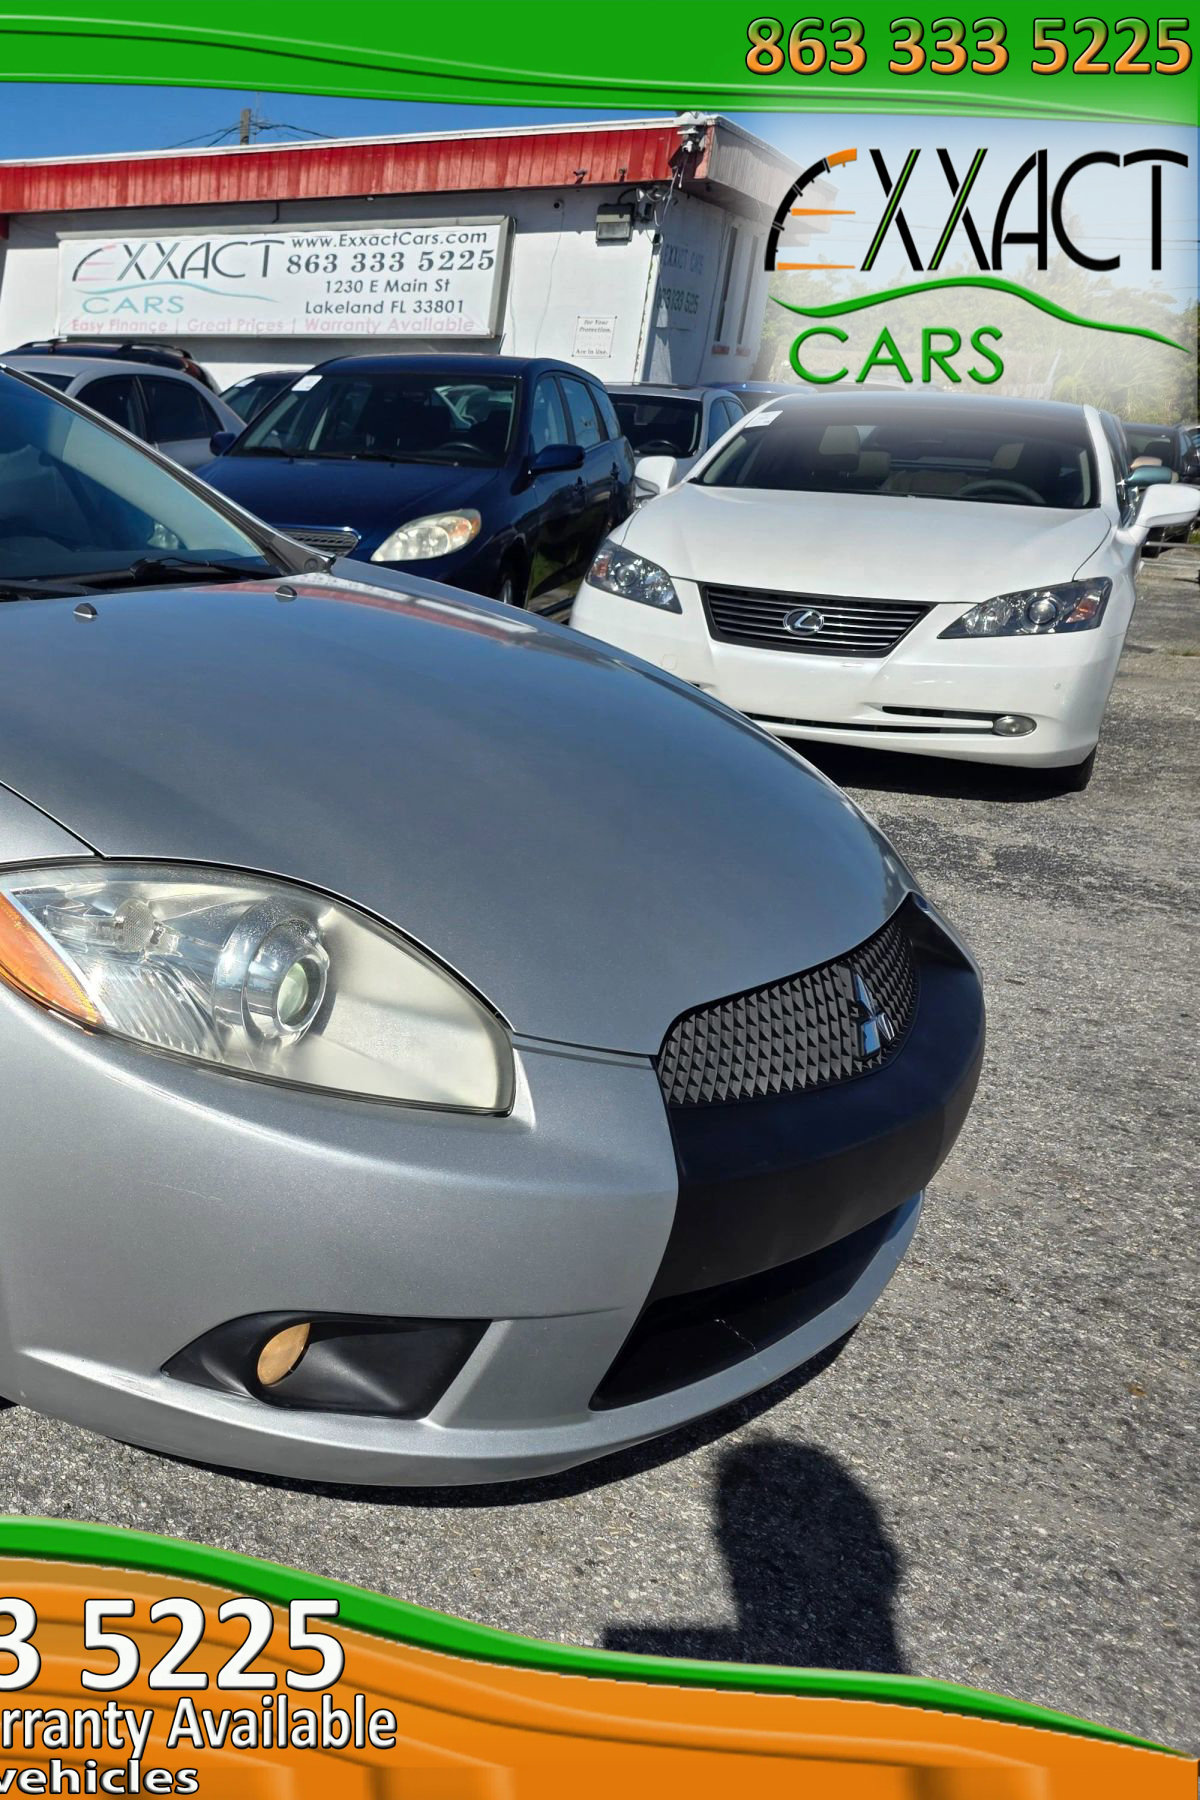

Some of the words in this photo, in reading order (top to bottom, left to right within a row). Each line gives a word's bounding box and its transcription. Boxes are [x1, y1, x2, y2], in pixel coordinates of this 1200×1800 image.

[292, 231, 487, 248] www.ExxactCars.com
[72, 240, 285, 281] EXXACT
[286, 253, 338, 274] 863
[351, 251, 405, 273] 333
[418, 249, 495, 271] 5225
[325, 279, 363, 294] 1230
[370, 279, 378, 293] E
[384, 279, 427, 293] Main
[435, 278, 450, 292] St
[82, 296, 184, 314] CARS
[305, 300, 384, 314] Lakeland
[391, 300, 406, 314] FL
[413, 299, 464, 314] 33801
[72, 319, 104, 334] Easy
[109, 319, 168, 332] Finance
[187, 319, 227, 333] Great
[234, 319, 284, 333] Prices
[305, 318, 380, 334] Warranty
[388, 318, 474, 333] Available
